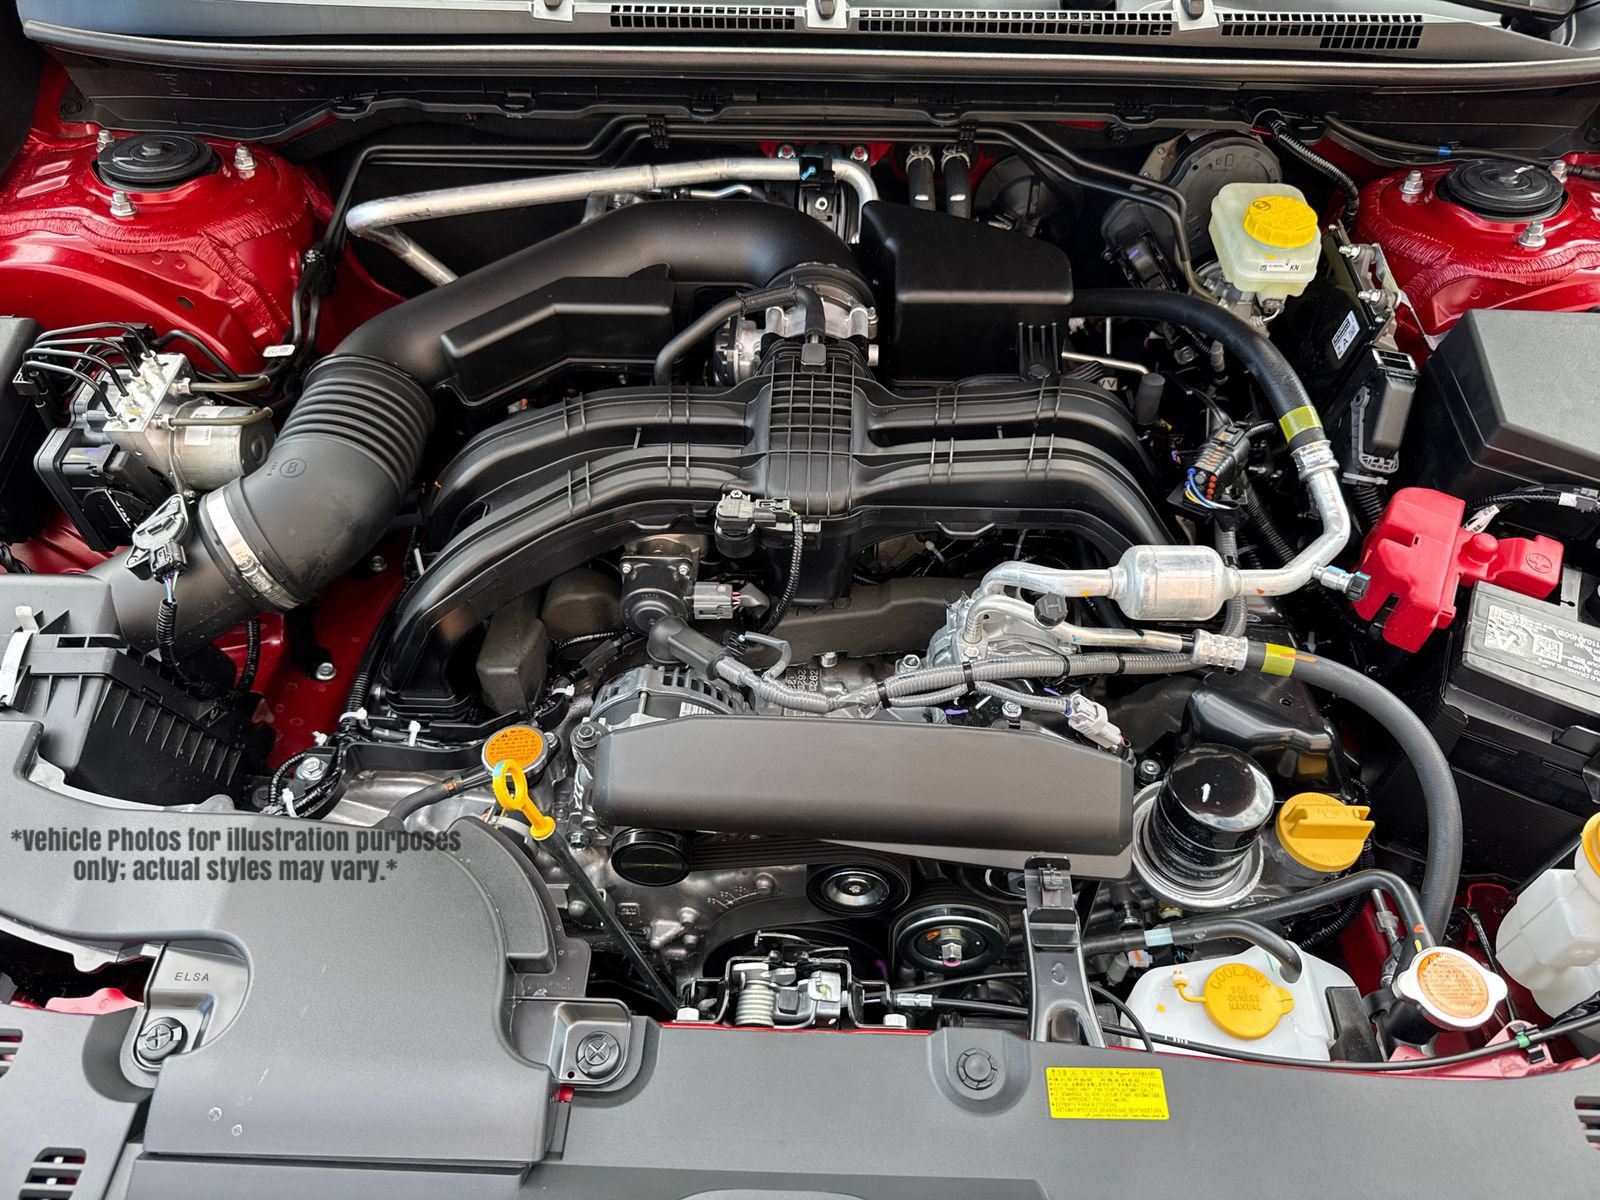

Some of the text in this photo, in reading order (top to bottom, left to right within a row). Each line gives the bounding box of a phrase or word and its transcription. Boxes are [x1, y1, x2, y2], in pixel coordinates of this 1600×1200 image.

[174, 971, 209, 982] ELSA
[1210, 966, 1271, 990] COOLANT
[1230, 986, 1248, 994] SEE
[1227, 994, 1261, 1002] OWNERS
[1229, 1003, 1262, 1011] MANUAL
